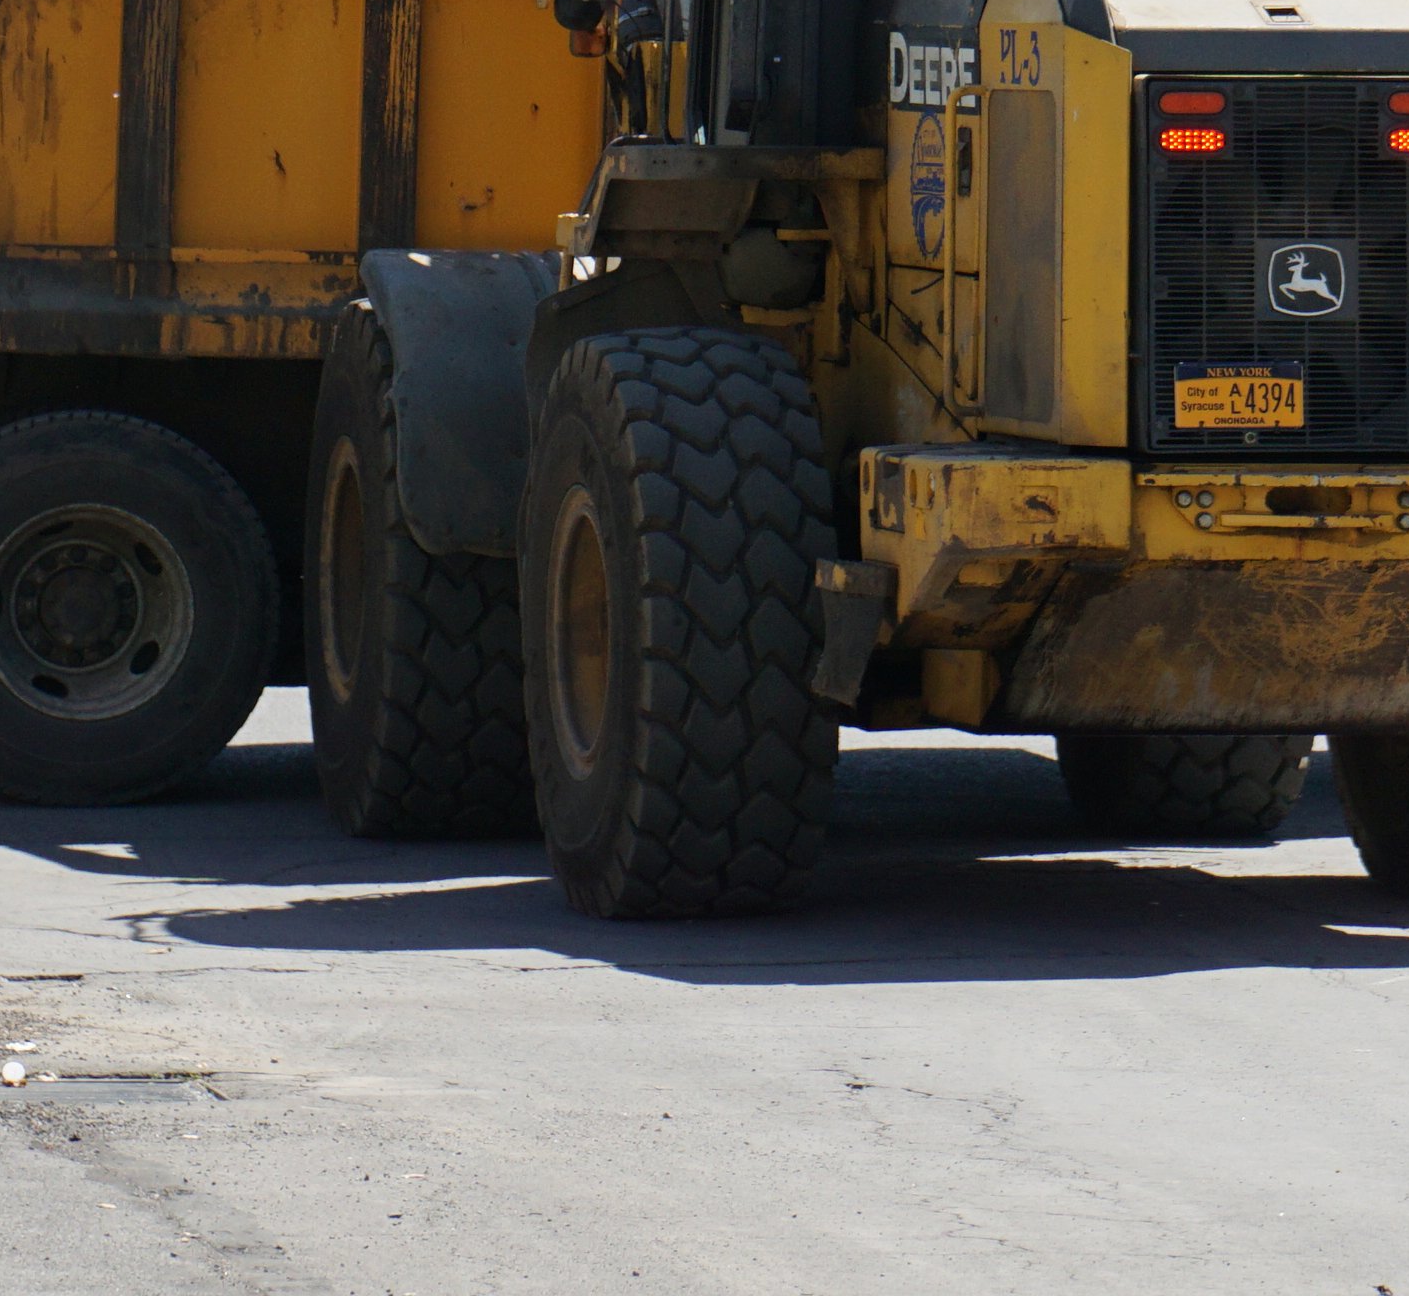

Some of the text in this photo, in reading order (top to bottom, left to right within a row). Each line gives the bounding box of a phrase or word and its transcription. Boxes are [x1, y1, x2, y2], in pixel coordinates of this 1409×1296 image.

[890, 31, 976, 108] DEERE
[1206, 367, 1272, 377] NEW YORK
[1187, 387, 1218, 398] City of
[1181, 401, 1224, 412] Syracuse
